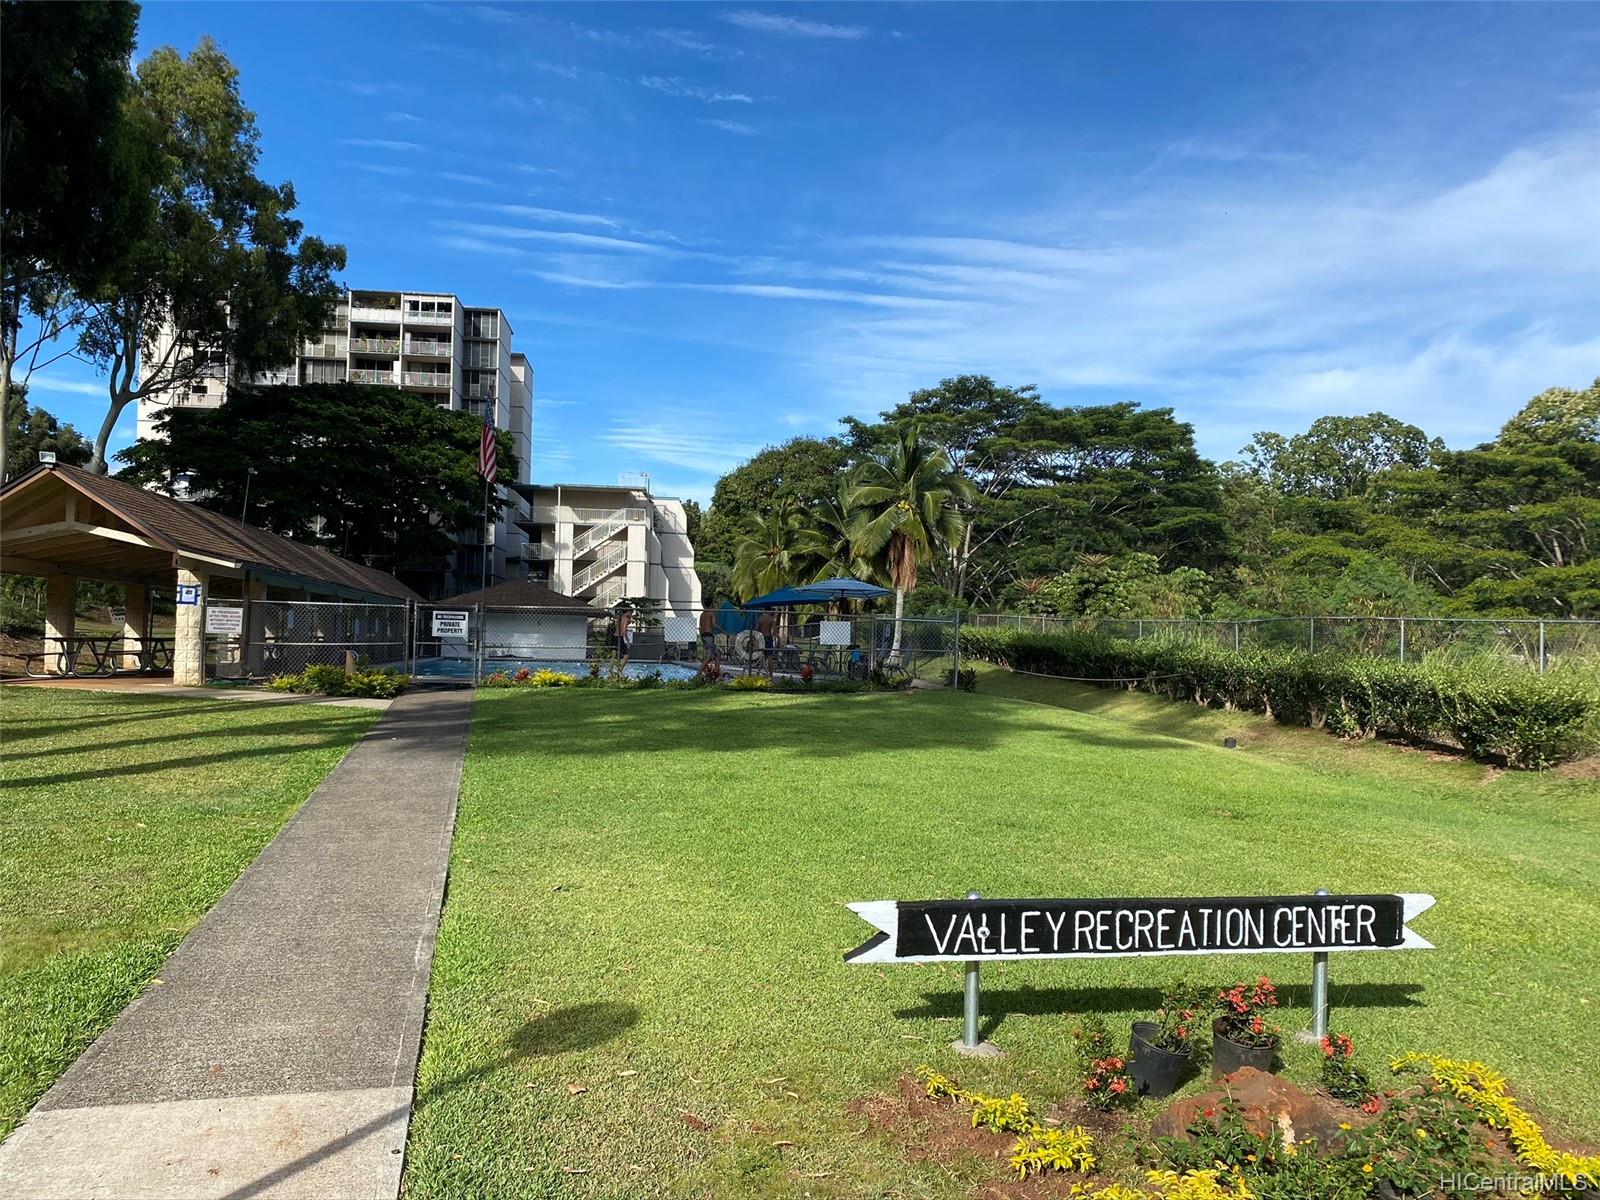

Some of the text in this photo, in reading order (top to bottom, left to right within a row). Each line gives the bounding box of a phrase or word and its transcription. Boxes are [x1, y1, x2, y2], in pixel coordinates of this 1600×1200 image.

[924, 904, 1377, 955] VALLEY RECREATION CENTER
